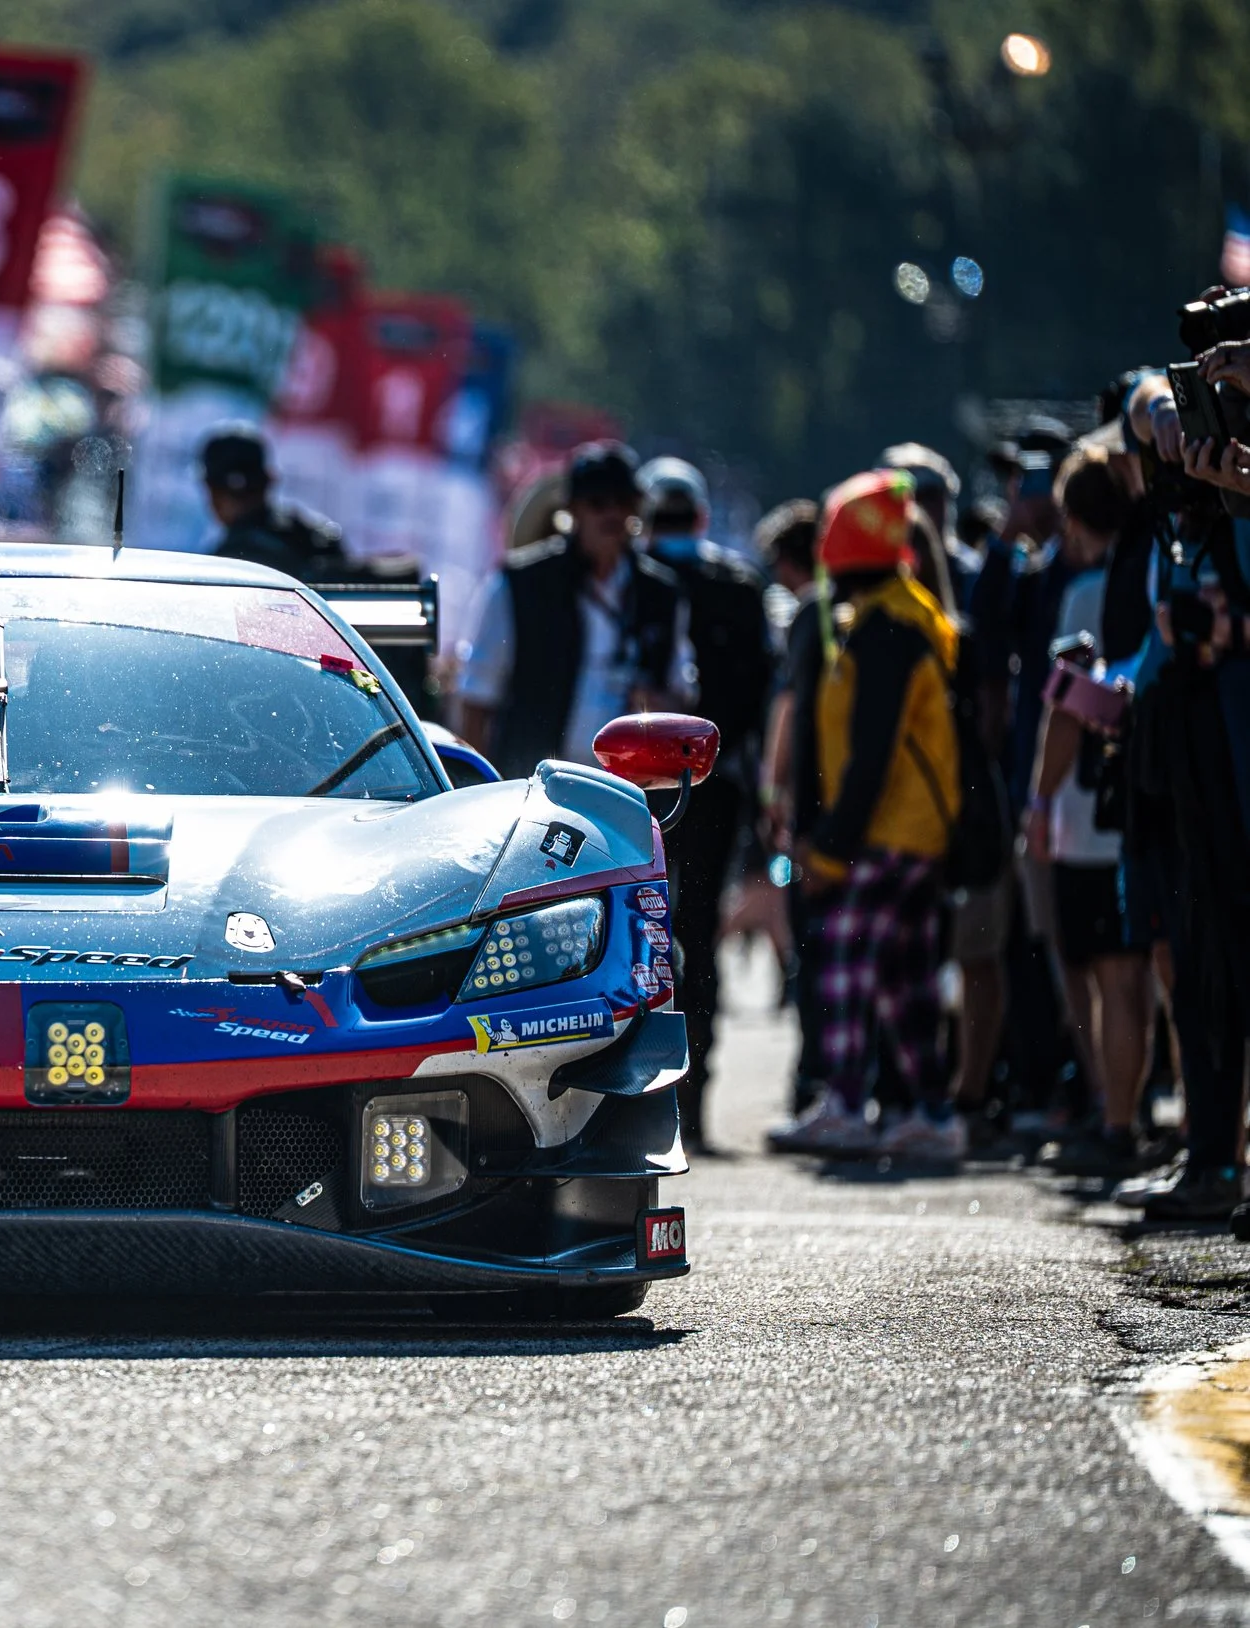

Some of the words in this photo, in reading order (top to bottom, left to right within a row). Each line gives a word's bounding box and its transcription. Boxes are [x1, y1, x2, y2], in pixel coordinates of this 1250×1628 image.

[639, 896, 667, 910] MOTUL
[214, 1021, 310, 1044] Speed
[521, 1012, 604, 1037] MICHELIN
[650, 1220, 686, 1252] MO
